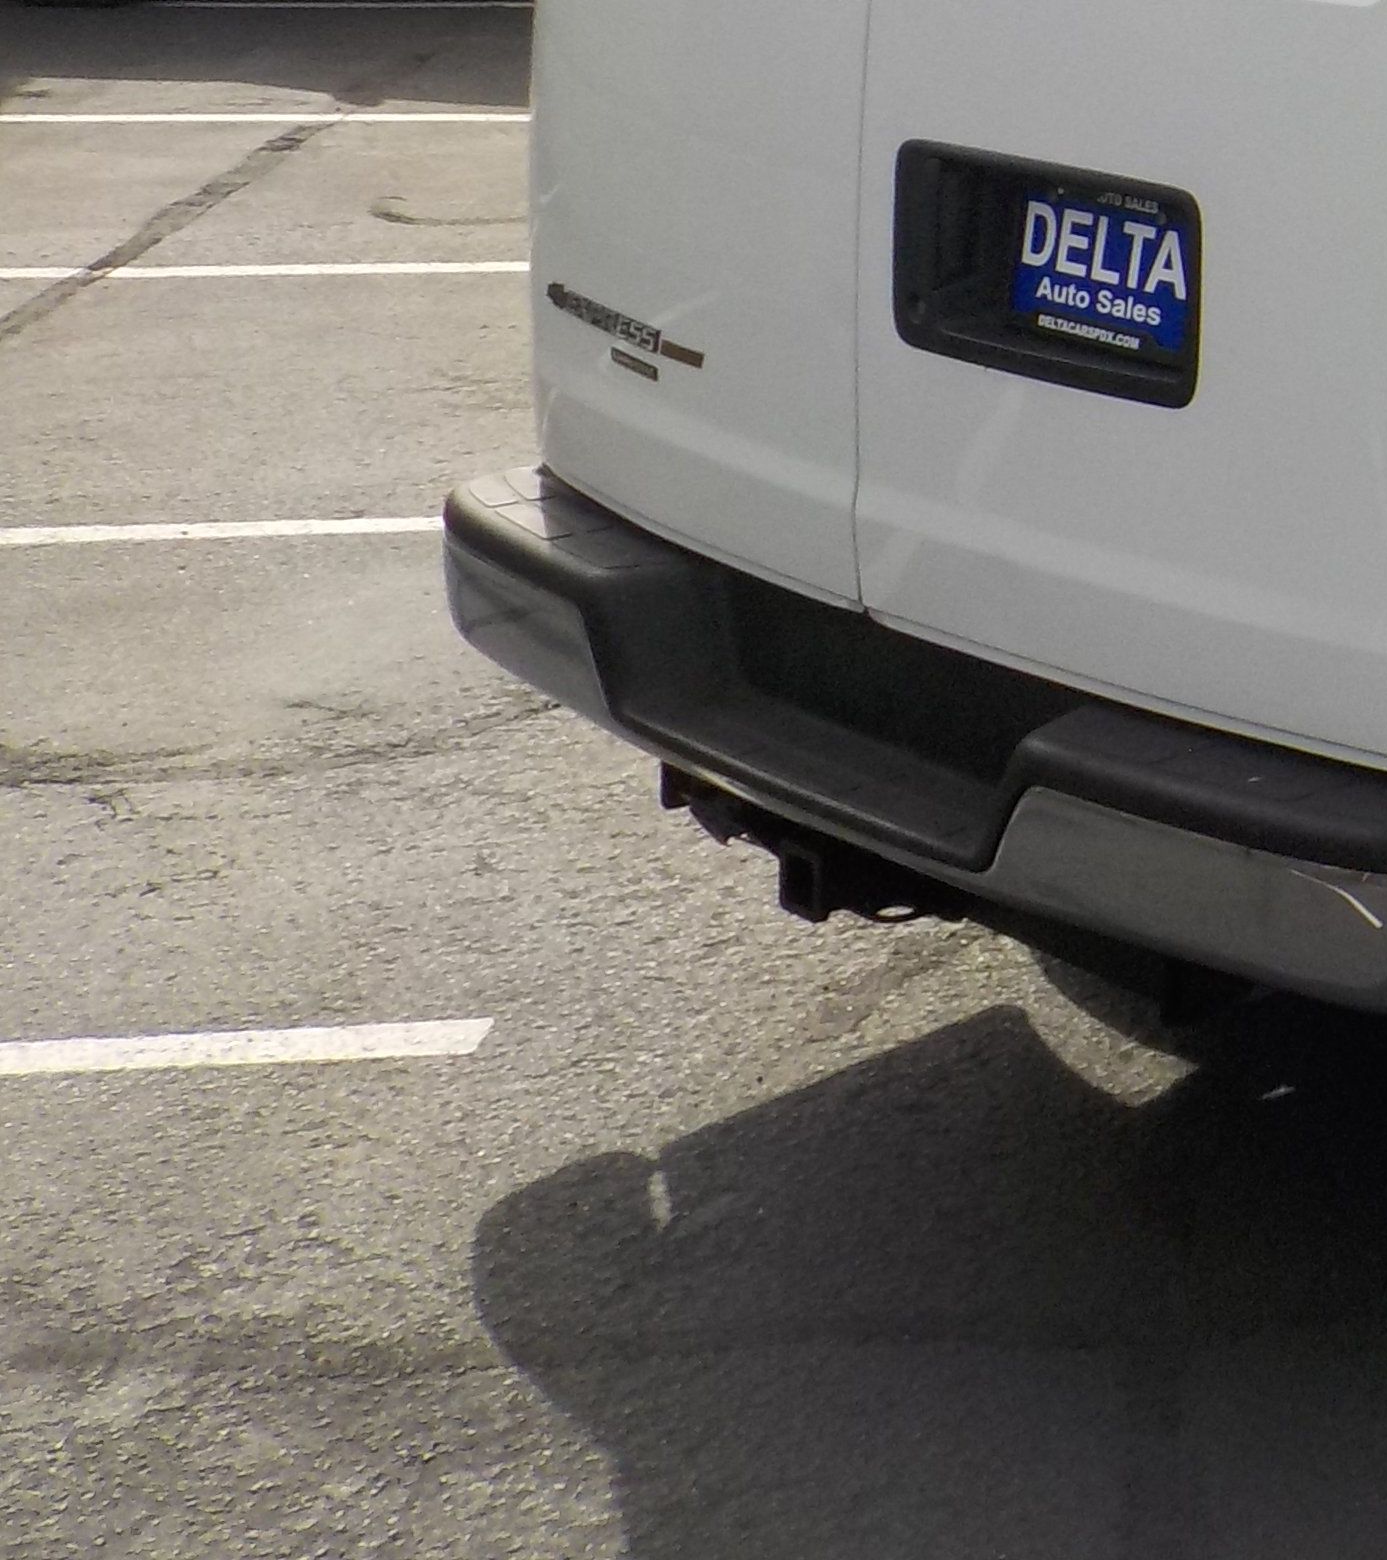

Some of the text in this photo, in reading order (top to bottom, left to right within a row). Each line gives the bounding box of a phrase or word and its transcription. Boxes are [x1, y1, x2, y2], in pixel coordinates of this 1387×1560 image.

[1020, 199, 1187, 301] DELTA
[1035, 276, 1162, 326] Auto Sales
